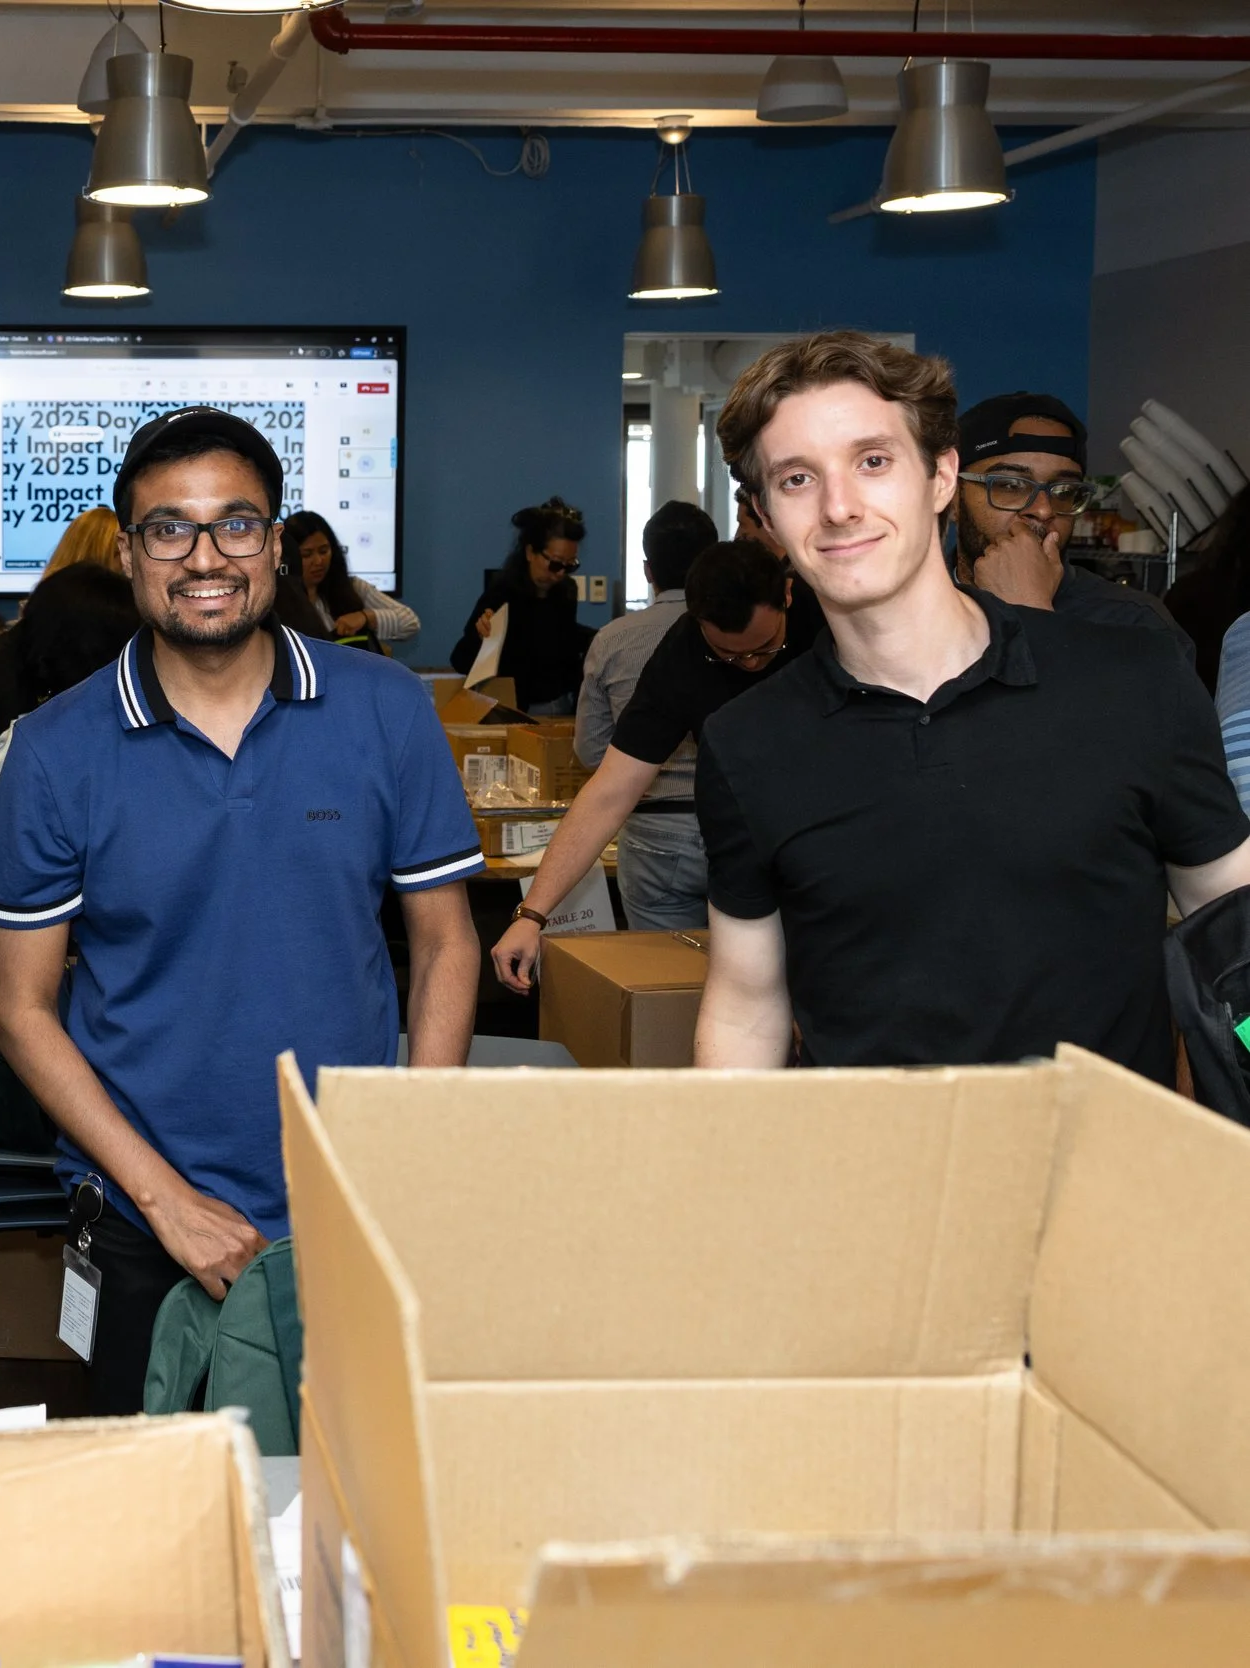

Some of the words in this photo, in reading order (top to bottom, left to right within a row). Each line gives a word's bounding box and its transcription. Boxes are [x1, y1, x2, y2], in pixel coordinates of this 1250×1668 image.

[31, 411, 89, 428] 2025
[97, 411, 141, 435] Day
[27, 435, 104, 459] Impact
[31, 457, 89, 475] 2025
[27, 482, 104, 506] Impact
[546, 911, 579, 928] TABLE
[580, 908, 594, 920] 20
